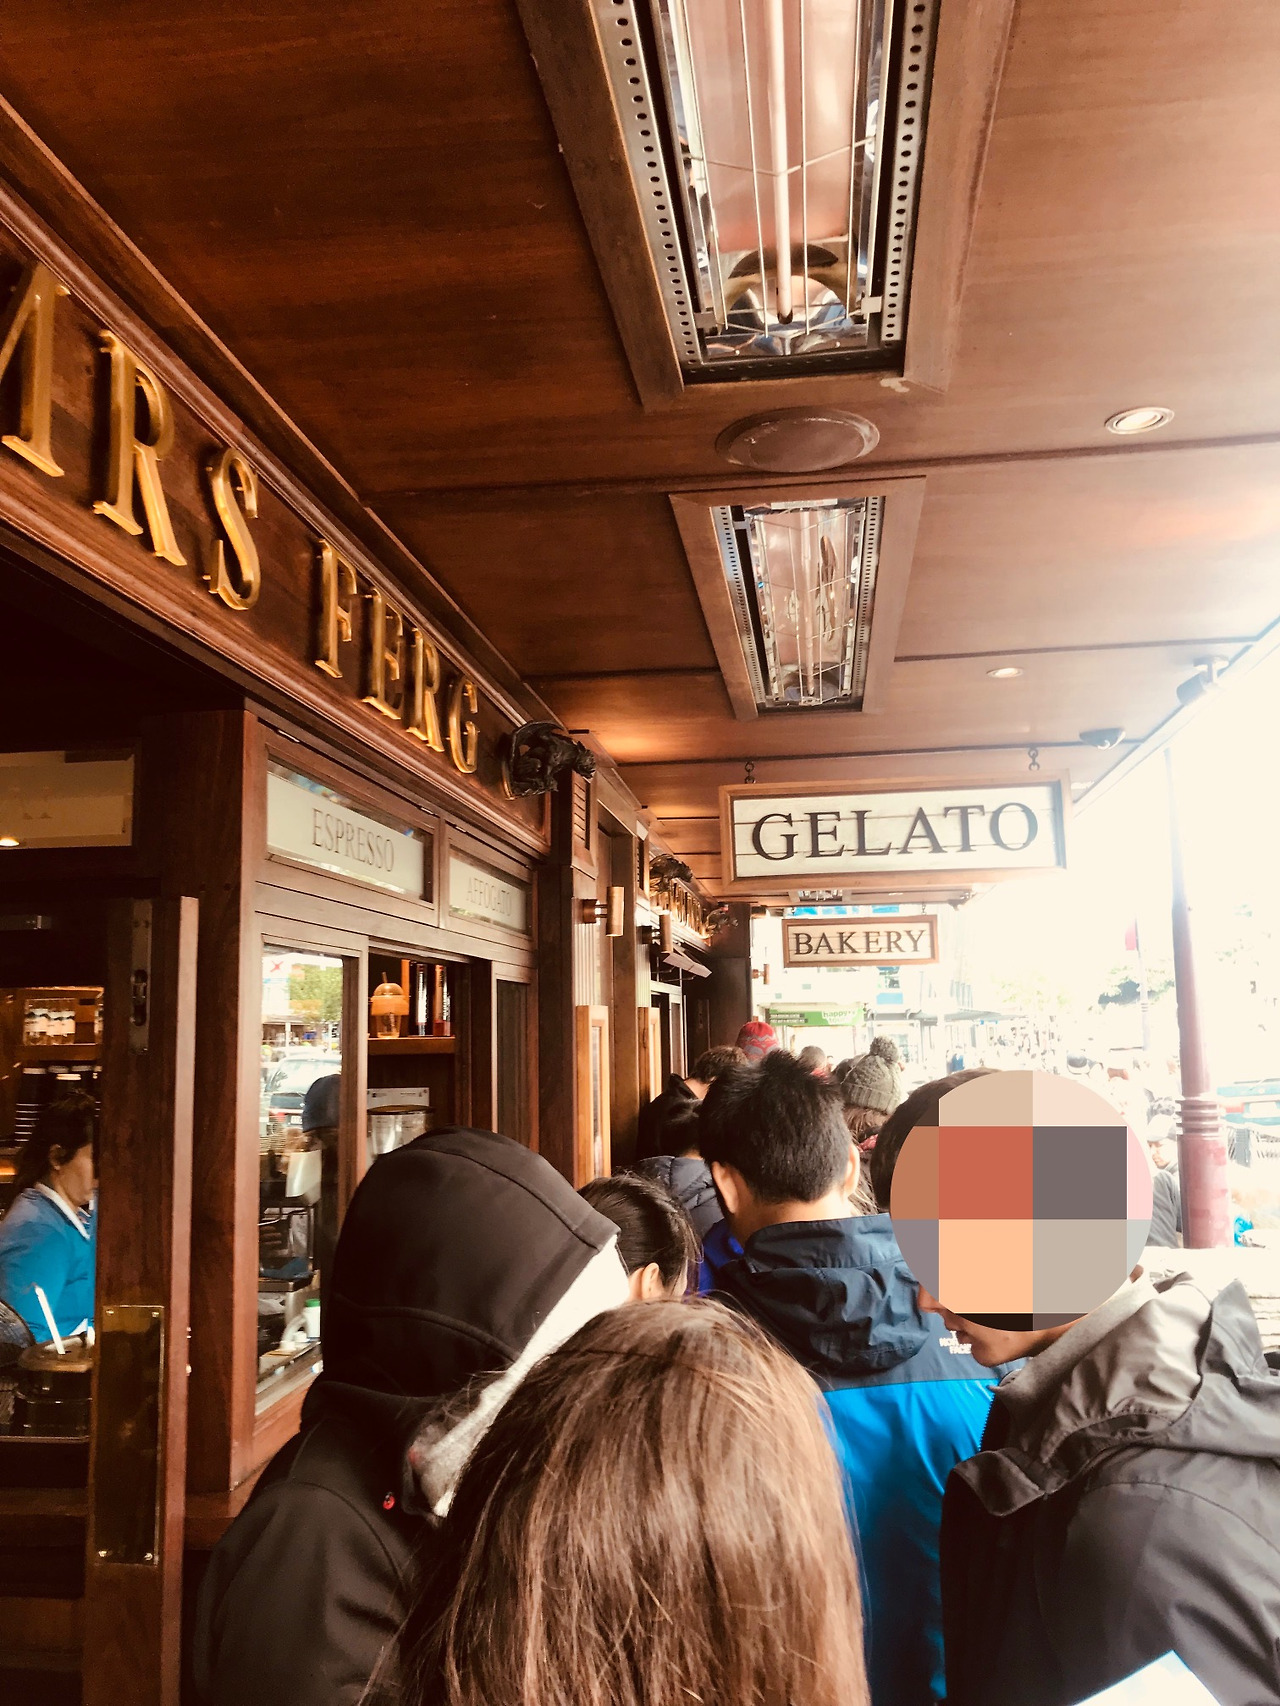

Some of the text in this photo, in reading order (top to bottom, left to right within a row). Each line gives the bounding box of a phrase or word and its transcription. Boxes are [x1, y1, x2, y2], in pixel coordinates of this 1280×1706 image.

[315, 537, 480, 774] FERG
[311, 807, 395, 873] ESPRESSO
[751, 801, 1039, 862] GELATO
[466, 876, 513, 917] AFFOGATO
[793, 929, 926, 956] BAKERY
